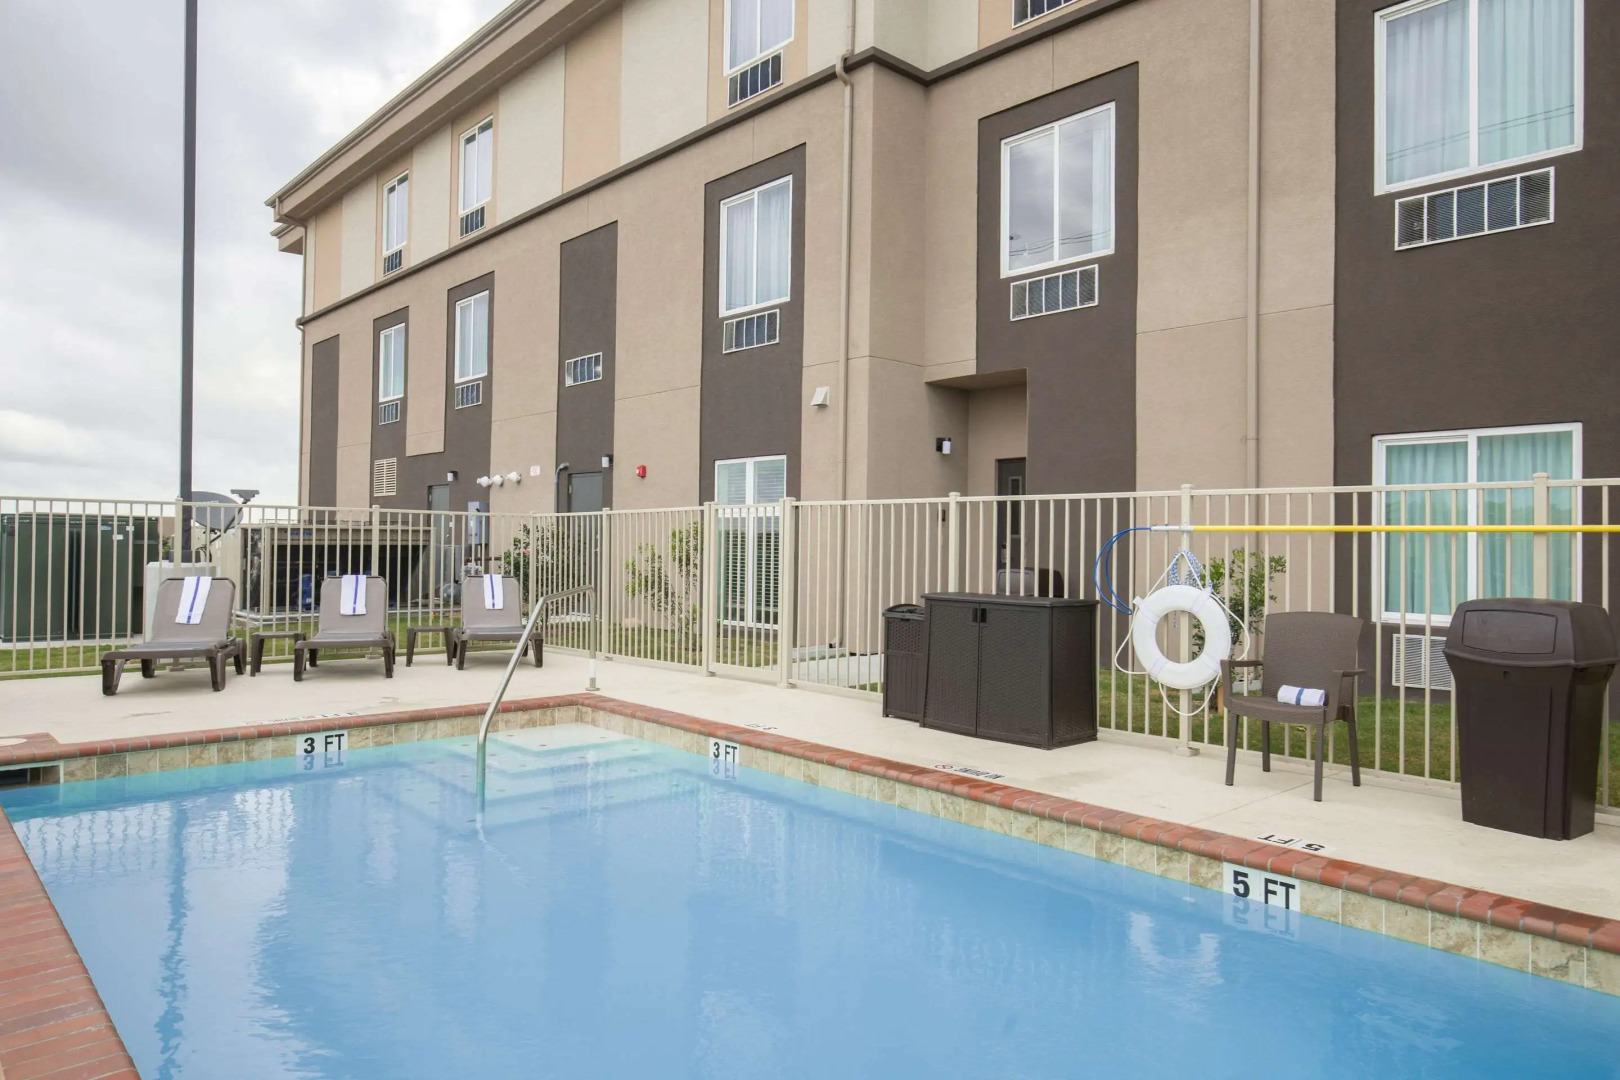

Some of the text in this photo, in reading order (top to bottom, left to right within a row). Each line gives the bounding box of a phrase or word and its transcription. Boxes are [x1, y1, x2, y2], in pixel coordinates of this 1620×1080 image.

[303, 733, 345, 754] 3 FT
[713, 741, 738, 763] 3 FT
[1256, 834, 1325, 852] 5 FT
[1232, 869, 1296, 910] 5 FT
